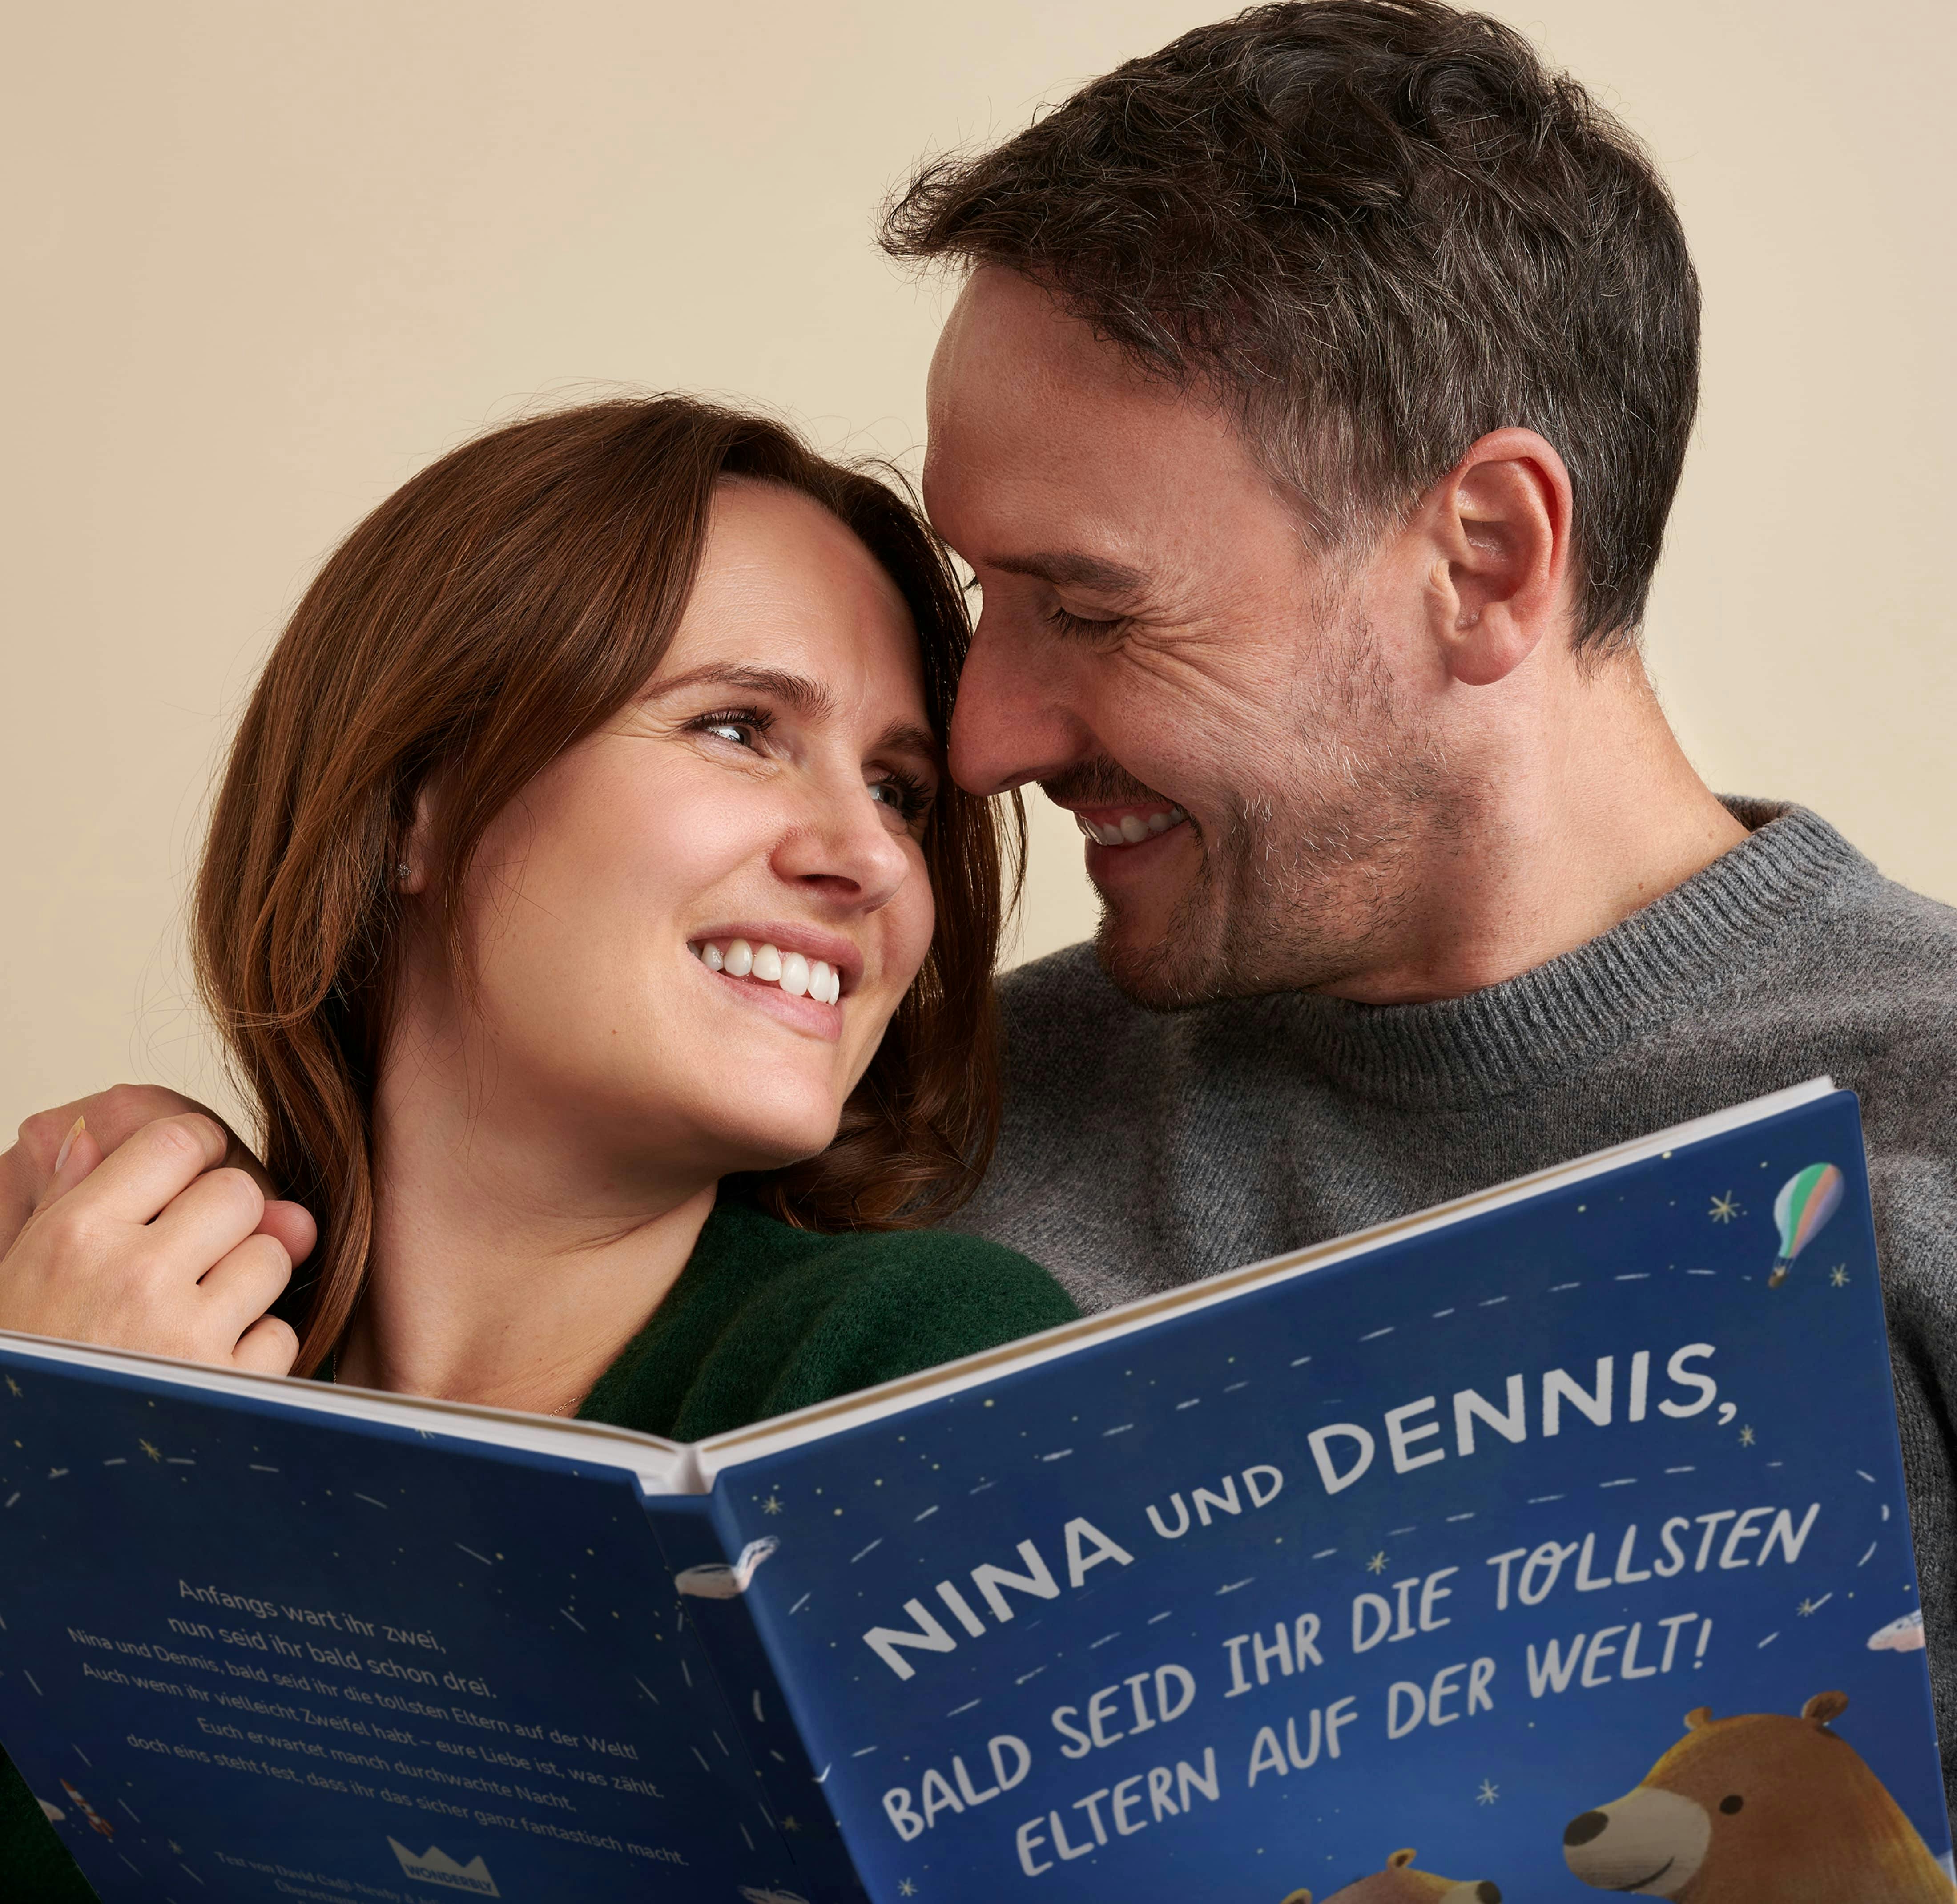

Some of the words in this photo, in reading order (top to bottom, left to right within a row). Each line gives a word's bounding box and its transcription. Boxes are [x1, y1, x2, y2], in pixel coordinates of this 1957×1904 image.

[863, 1517, 1134, 1680] NINA
[1146, 1465, 1283, 1538] UND
[1308, 1343, 1737, 1494] DENNIS,
[167, 1618, 215, 1640] nun
[218, 1628, 268, 1651] seid
[268, 1634, 302, 1658] ihr
[306, 1641, 362, 1670] bald
[366, 1658, 439, 1686] schon
[443, 1671, 497, 1698] drei.
[179, 1579, 278, 1619] Anfangs
[281, 1605, 342, 1630] wart
[341, 1612, 375, 1637] ihr
[381, 1625, 447, 1654] zwei,
[883, 1735, 1030, 1841] BALD
[1052, 1665, 1195, 1758] SEID
[1224, 1613, 1323, 1697] IHR
[1353, 1567, 1458, 1653] DIE
[1487, 1503, 1820, 1610] TOLLSTEN
[67, 1627, 113, 1650] Nina
[115, 1641, 153, 1658] und
[152, 1645, 225, 1674] Dennis,
[224, 1660, 270, 1682] bald
[272, 1673, 312, 1692] seid
[311, 1678, 338, 1697] ihr
[343, 1686, 374, 1705] die
[374, 1692, 450, 1721] tollsten
[451, 1707, 511, 1733] Eltern
[513, 1724, 544, 1740] auf
[549, 1729, 579, 1747] der
[583, 1735, 639, 1760] Welt!
[83, 1662, 130, 1686] Auch
[131, 1676, 184, 1696] wenn
[184, 1683, 209, 1702] ihr
[213, 1692, 300, 1721] vielleicht
[299, 1708, 371, 1737] Zweifel
[371, 1723, 418, 1746] habt
[435, 1740, 478, 1759] eure
[479, 1746, 532, 1771] Liebe
[533, 1757, 565, 1779] ist,
[567, 1768, 608, 1787] was
[611, 1776, 664, 1798] zählt.
[1017, 1747, 1219, 1876] ELTERN
[1249, 1696, 1357, 1787] AUF
[1388, 1658, 1495, 1739] DER
[1527, 1613, 1712, 1698] WELT!
[126, 1733, 171, 1755] doch
[173, 1744, 211, 1763] eins
[213, 1754, 262, 1774] steht
[260, 1761, 304, 1784] fest,
[306, 1772, 349, 1793] dass
[349, 1780, 374, 1798] ihr
[380, 1787, 413, 1807] das
[415, 1798, 469, 1818] sicher
[473, 1810, 519, 1829] ganz
[520, 1817, 623, 1852] fantastisch
[626, 1843, 689, 1866] macht.
[196, 1717, 244, 1740] Euch
[247, 1731, 328, 1758] erwartet
[330, 1749, 391, 1771] manch
[394, 1760, 513, 1797] durchwachte
[514, 1785, 577, 1812] Nacht,
[214, 1850, 248, 1868] Text
[248, 1860, 275, 1874] von
[274, 1863, 316, 1883] David
[405, 1864, 491, 1892] WONDERBLY
